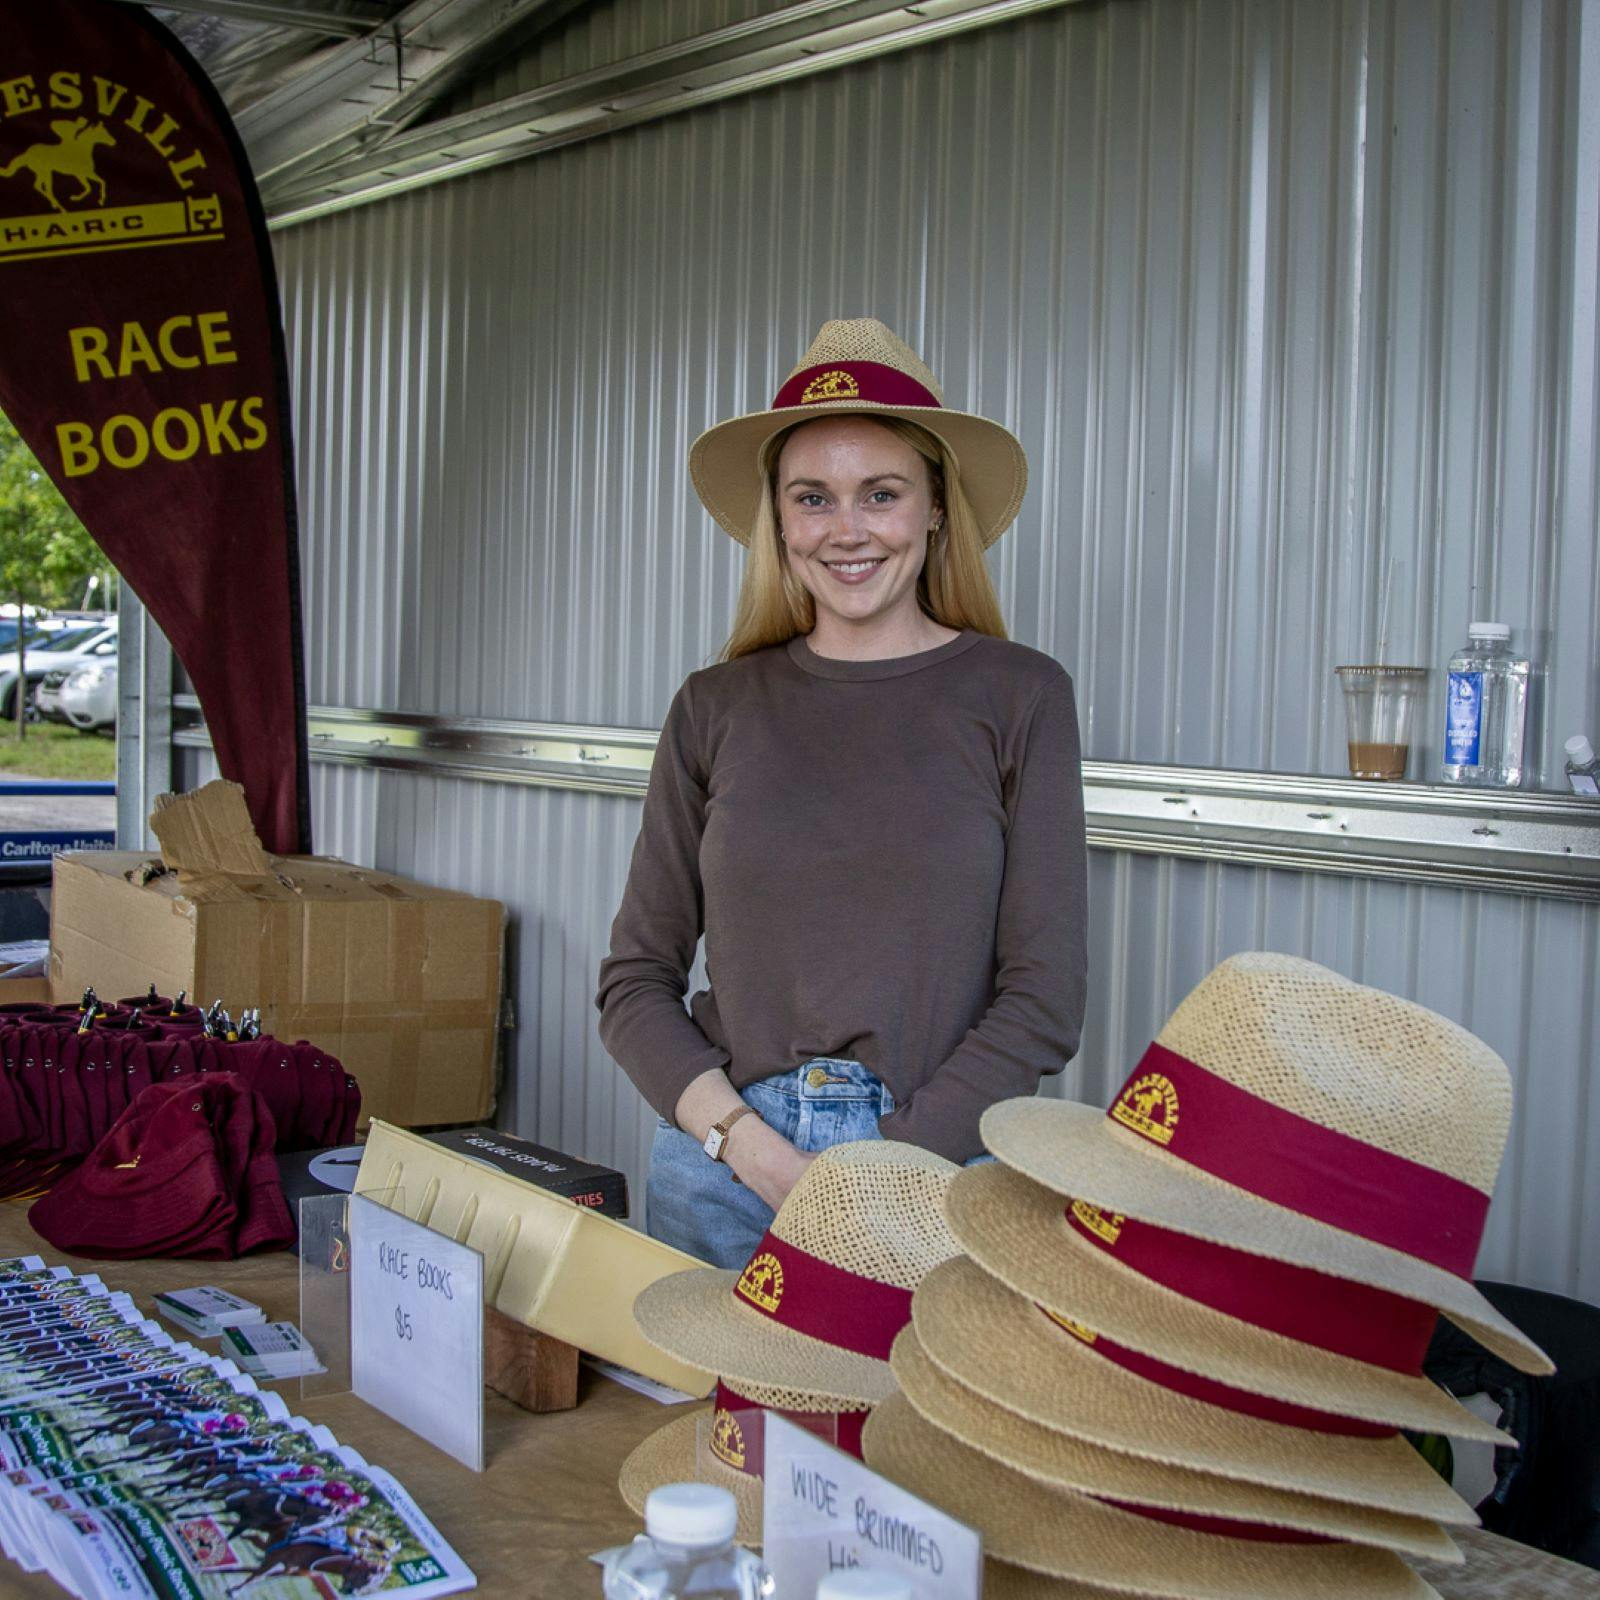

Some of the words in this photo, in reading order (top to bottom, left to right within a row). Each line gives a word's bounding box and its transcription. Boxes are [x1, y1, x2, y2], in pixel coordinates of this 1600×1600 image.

[0, 71, 223, 231] ESVILLE
[69, 311, 238, 383] RACE
[56, 397, 268, 477] BOOKS
[3, 840, 60, 856] Carlton
[73, 839, 114, 851] Unite
[380, 1241, 408, 1279] RACE
[418, 1258, 453, 1300] BOOKS
[395, 1304, 412, 1341] $5
[792, 1462, 838, 1518] WIDE
[855, 1496, 944, 1575] BRIMMED
